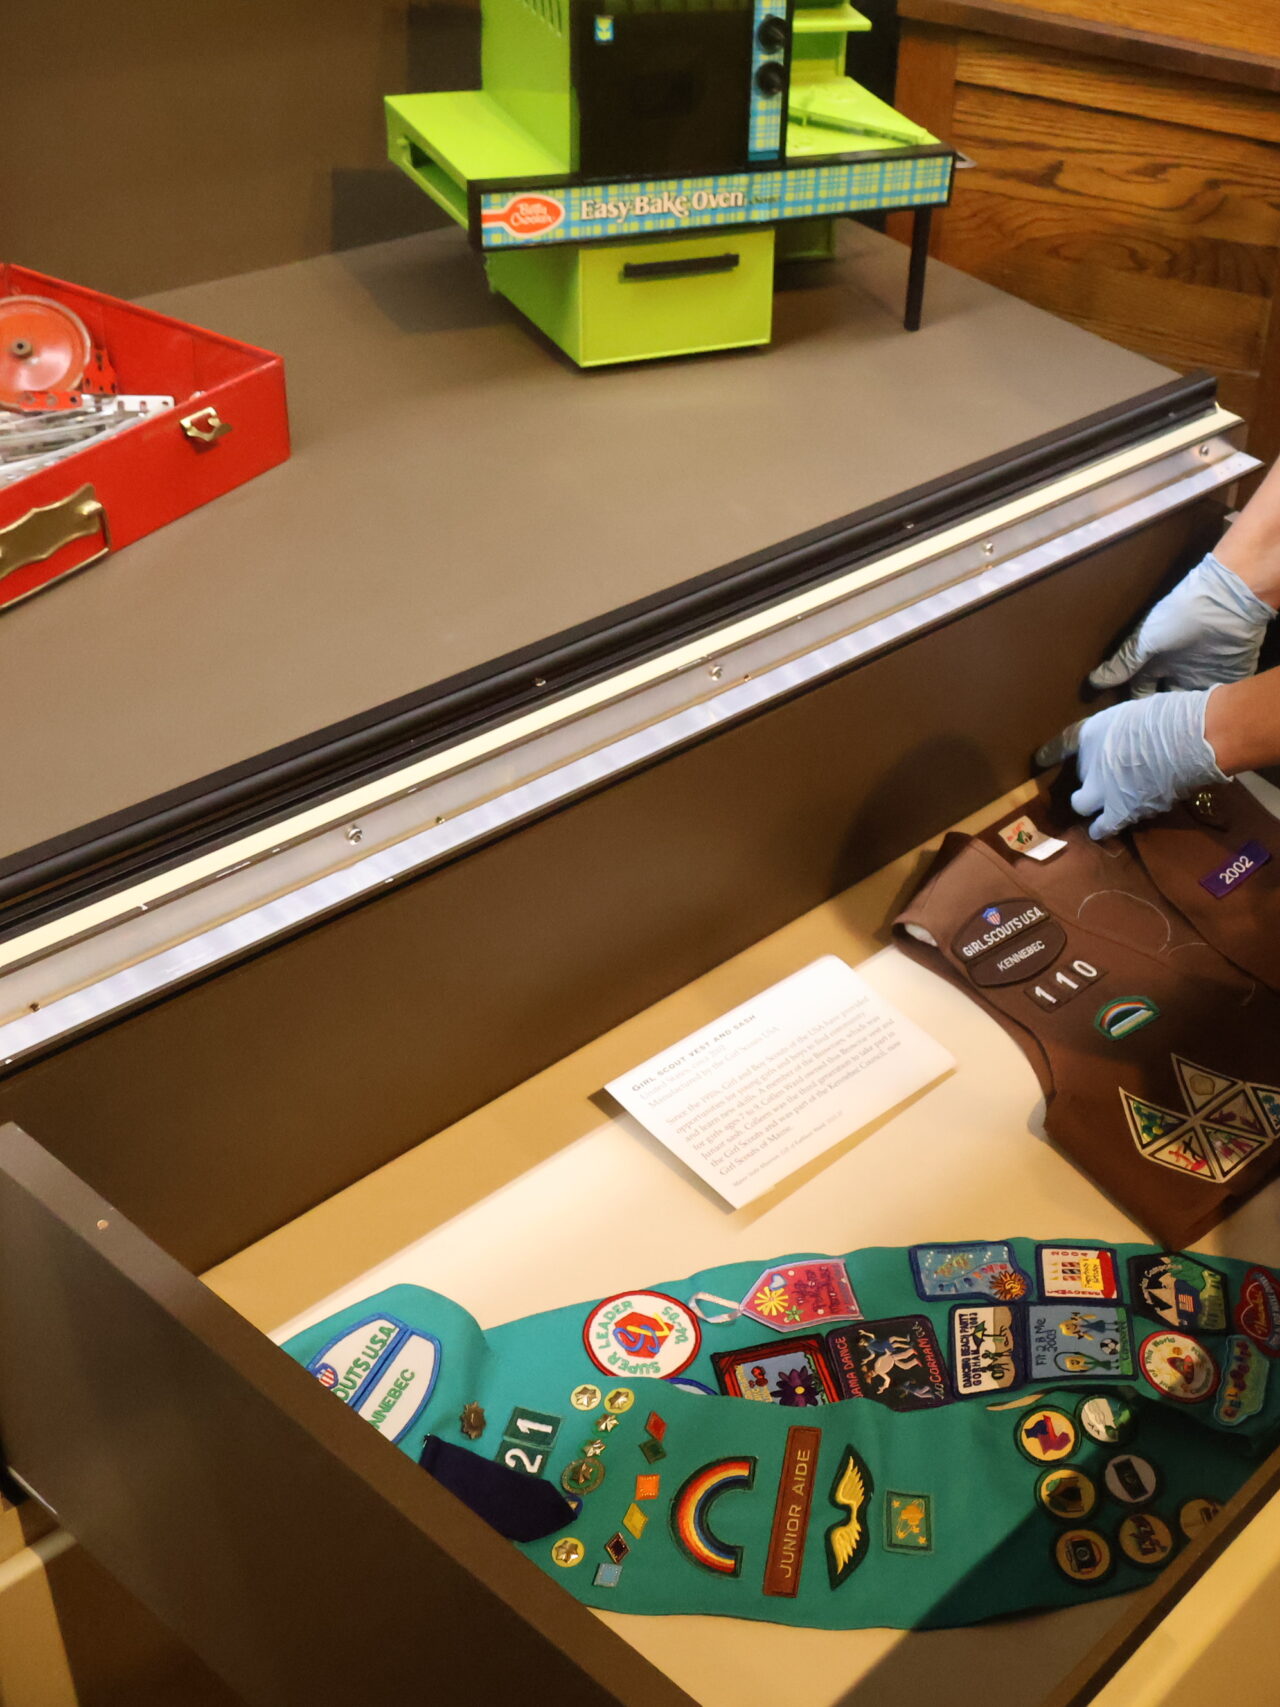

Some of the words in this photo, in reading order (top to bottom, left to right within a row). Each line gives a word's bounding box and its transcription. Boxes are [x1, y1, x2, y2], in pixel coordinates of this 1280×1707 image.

[691, 190, 744, 210] Oven
[1219, 855, 1254, 885] 2002
[962, 939, 989, 957] GIRL
[983, 917, 1022, 946] SCOUTS
[996, 940, 1046, 972] KENNEBEC
[632, 1077, 655, 1091] GIRL
[657, 1058, 687, 1075] SCOUT
[689, 1043, 711, 1056] VEST
[713, 1031, 731, 1041] AND
[733, 1016, 756, 1029] SASH
[723, 1146, 740, 1157] Girl
[738, 1131, 764, 1147] Scouts
[763, 1121, 778, 1131] and
[779, 1113, 794, 1122] was
[792, 1102, 810, 1114] part
[719, 1163, 736, 1175] Girl
[734, 1147, 760, 1165] Scouts
[595, 1300, 634, 1350] LEADER
[958, 1313, 969, 1334] PARTY
[1034, 1318, 1047, 1334] Me
[607, 1351, 661, 1375] SUPER
[835, 1335, 856, 1371] DANCE
[918, 1338, 942, 1383] GORHAM
[959, 1335, 971, 1356] BEACH
[331, 1357, 371, 1401] OUTS
[961, 1357, 973, 1389] DANCING
[970, 1349, 982, 1387] GORHAM
[368, 1368, 416, 1430] NNEBEC
[779, 1504, 802, 1579] JUNIOR
[791, 1449, 811, 1497] AIDE
